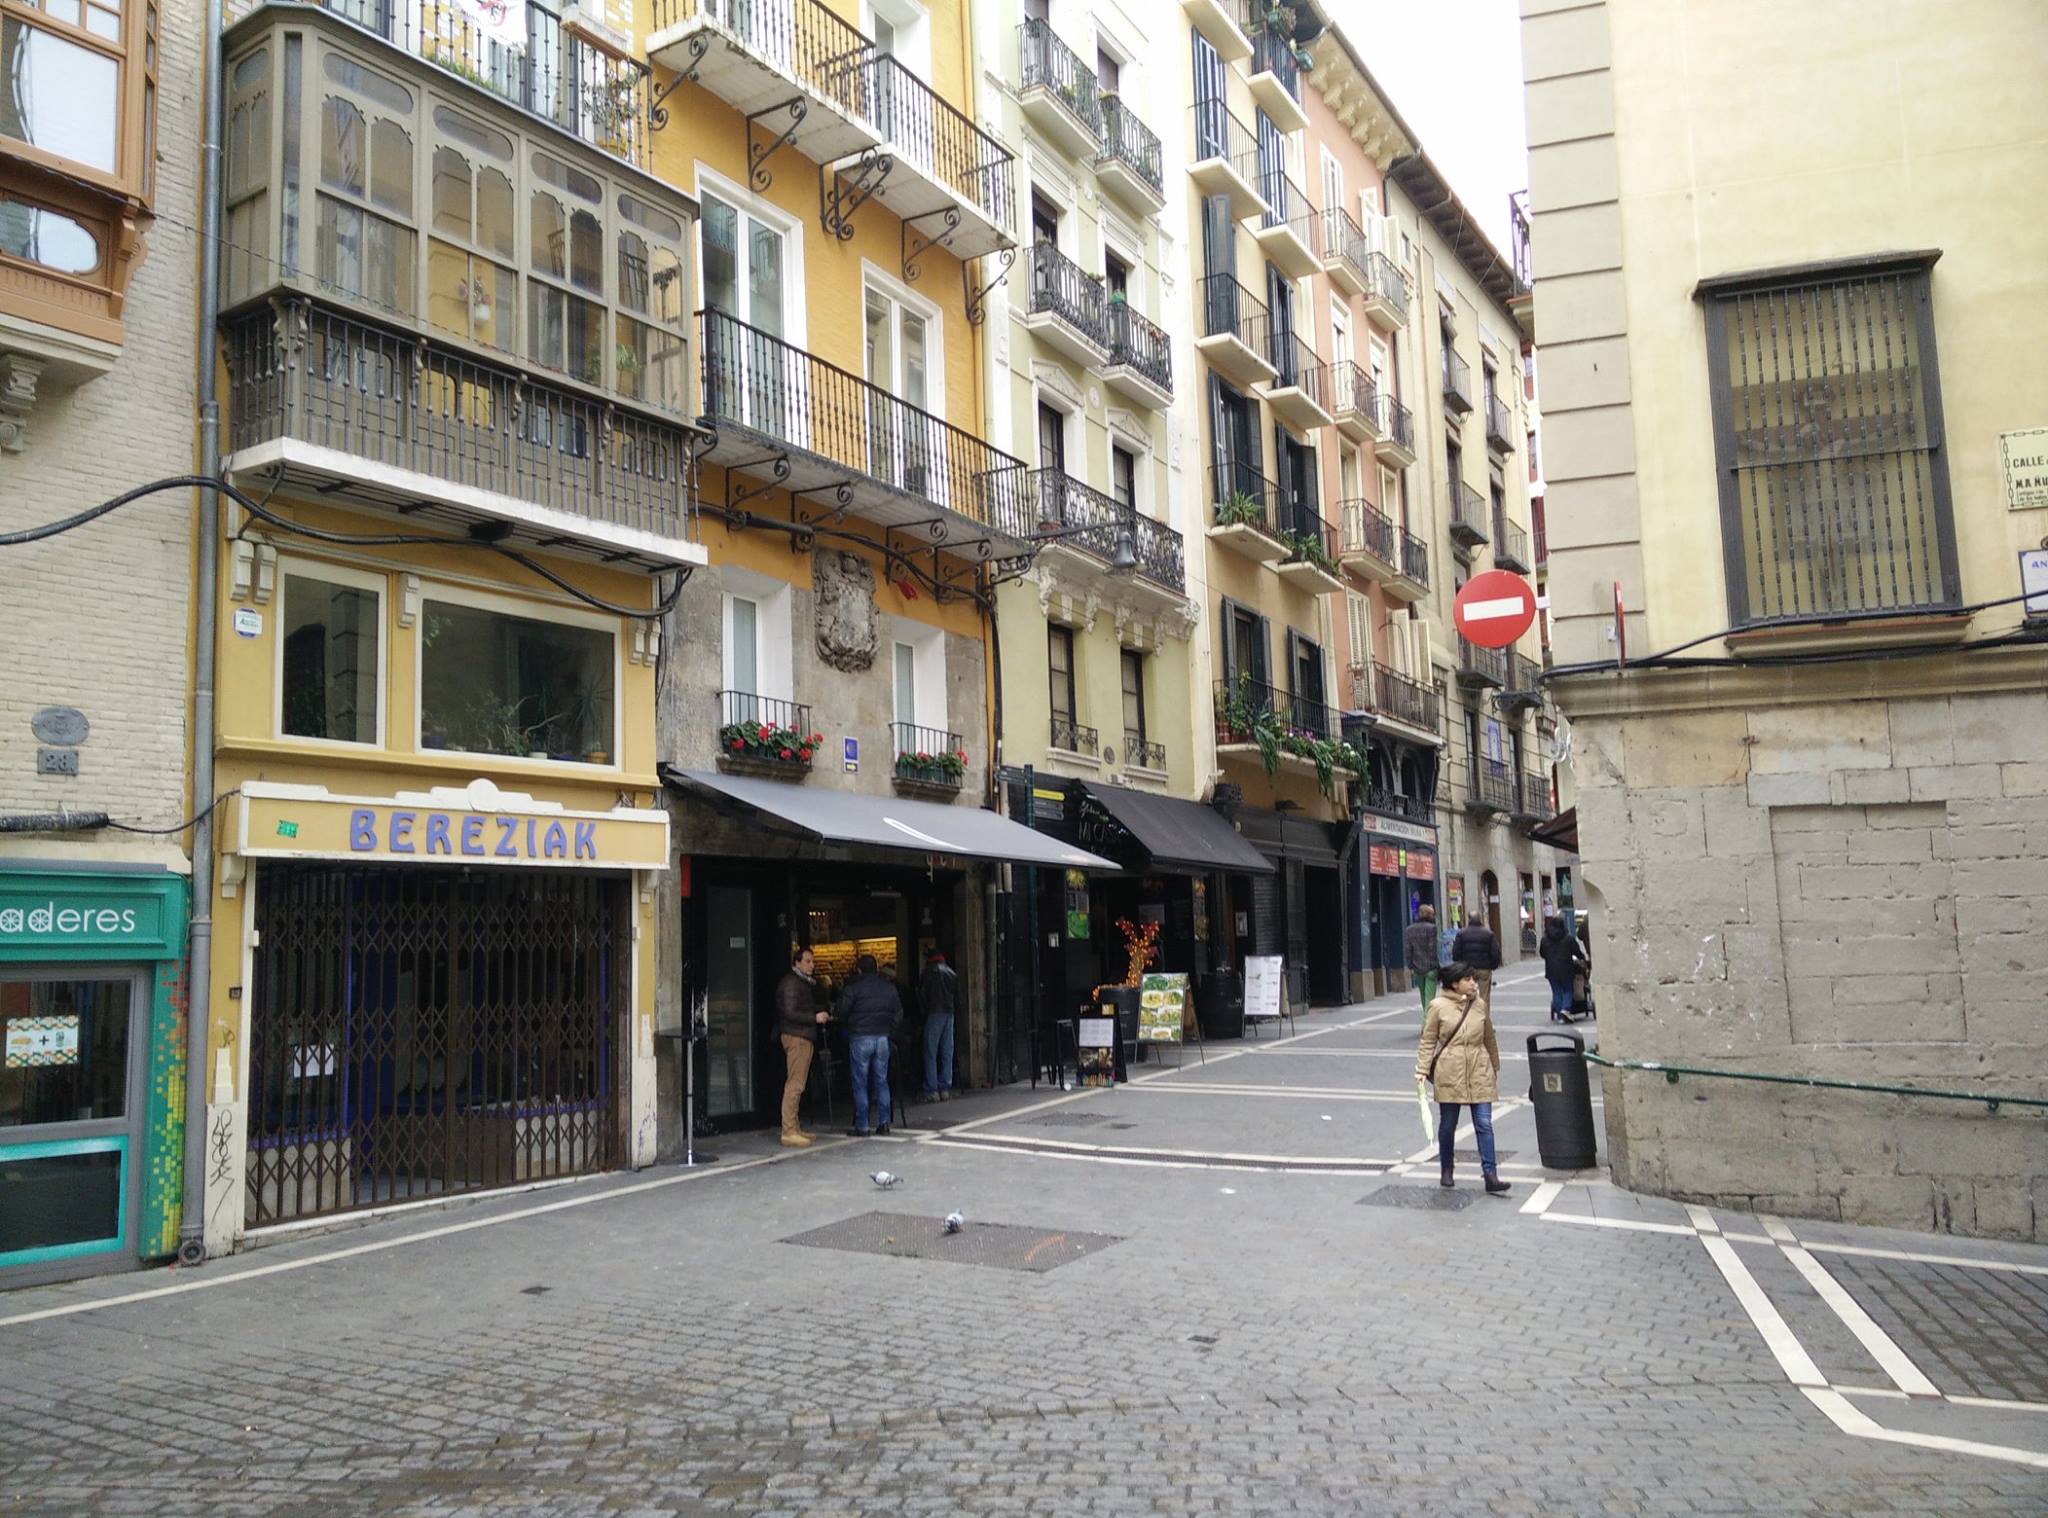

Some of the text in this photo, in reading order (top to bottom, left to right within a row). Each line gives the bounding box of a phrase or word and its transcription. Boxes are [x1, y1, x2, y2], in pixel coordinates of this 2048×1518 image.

[2013, 456, 2044, 468] CALLE
[350, 809, 597, 860] BEREZIAK
[0, 901, 136, 933] aderes
